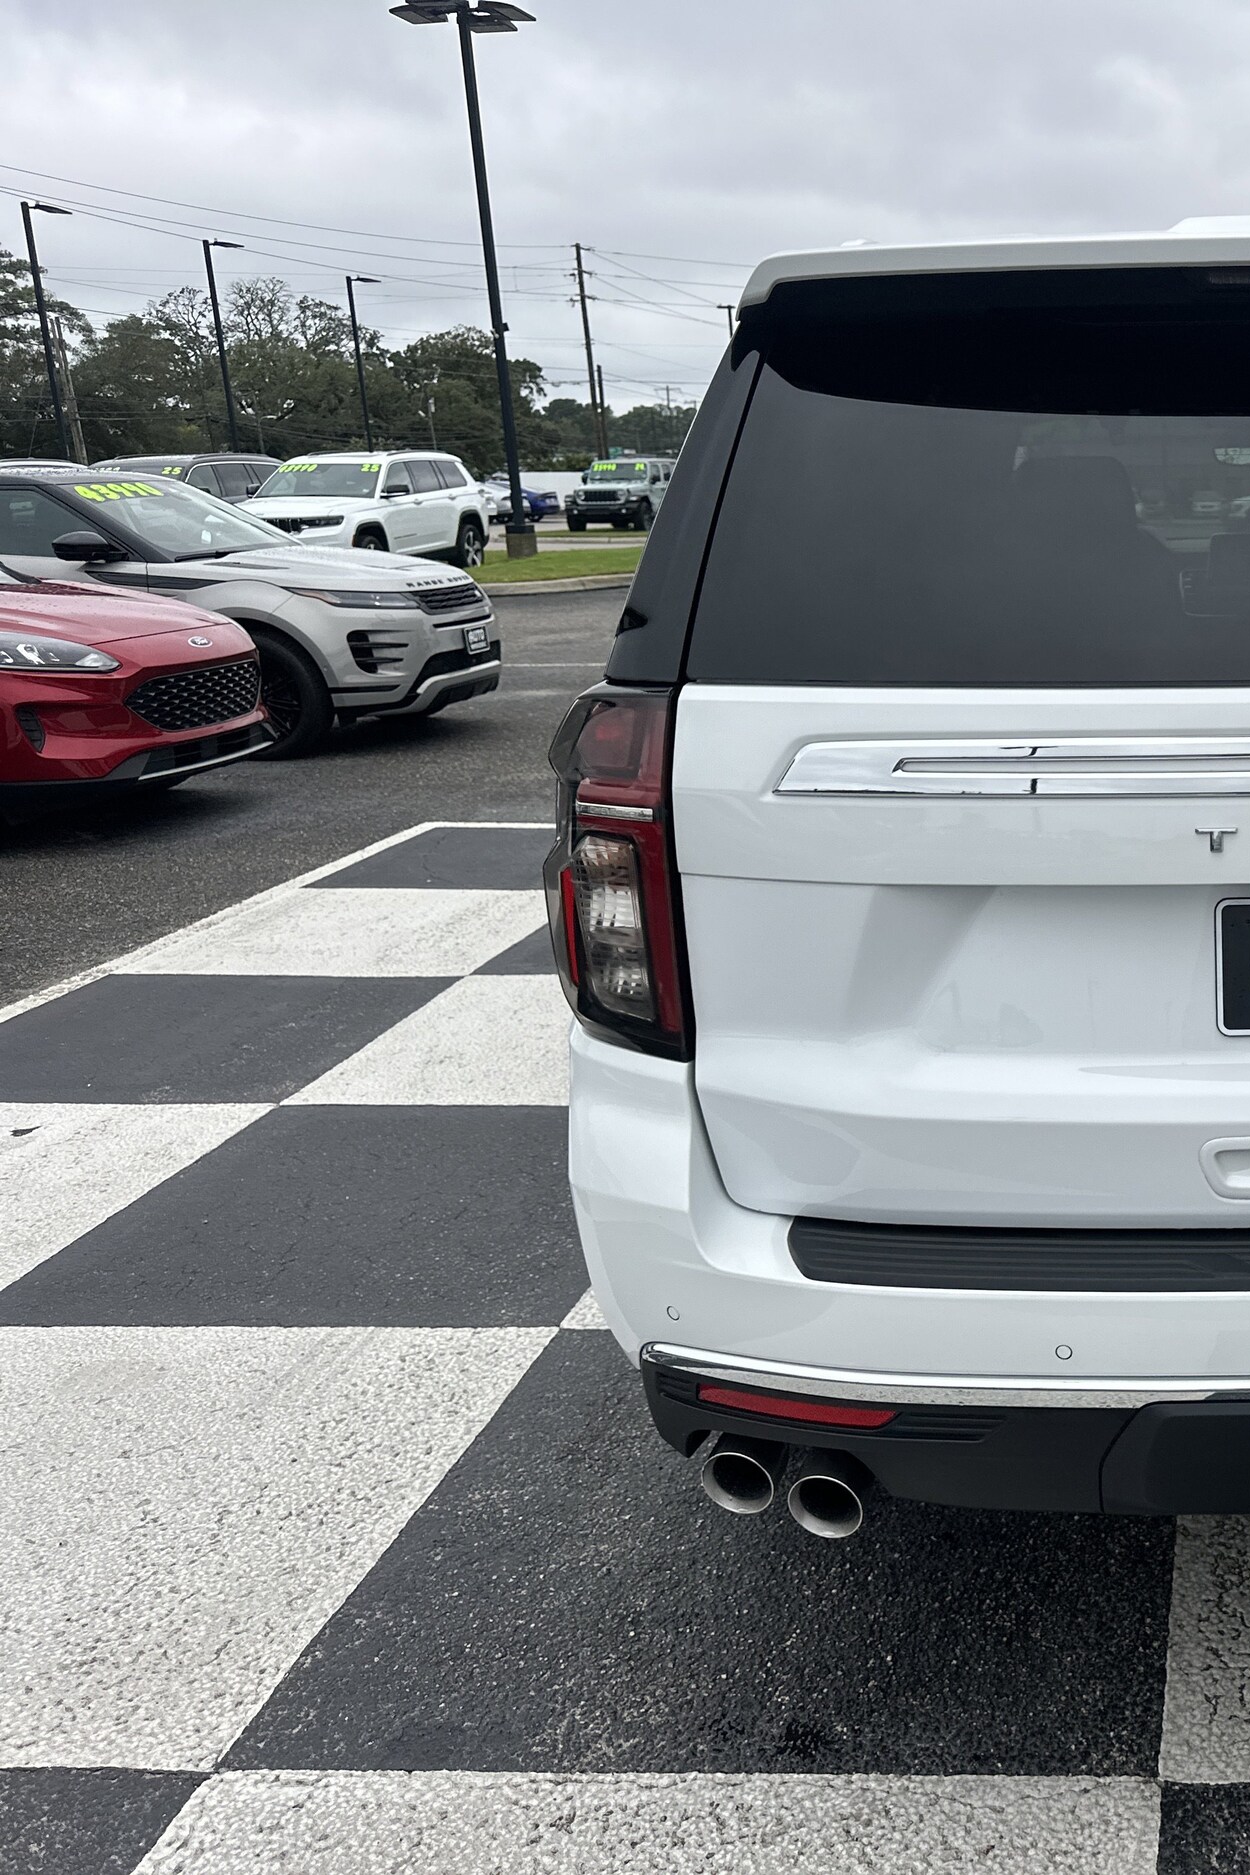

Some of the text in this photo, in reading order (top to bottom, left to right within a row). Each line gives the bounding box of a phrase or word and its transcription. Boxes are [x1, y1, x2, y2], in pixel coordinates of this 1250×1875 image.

[161, 466, 183, 475] 25
[360, 464, 380, 472] 25
[73, 482, 165, 502] 43990
